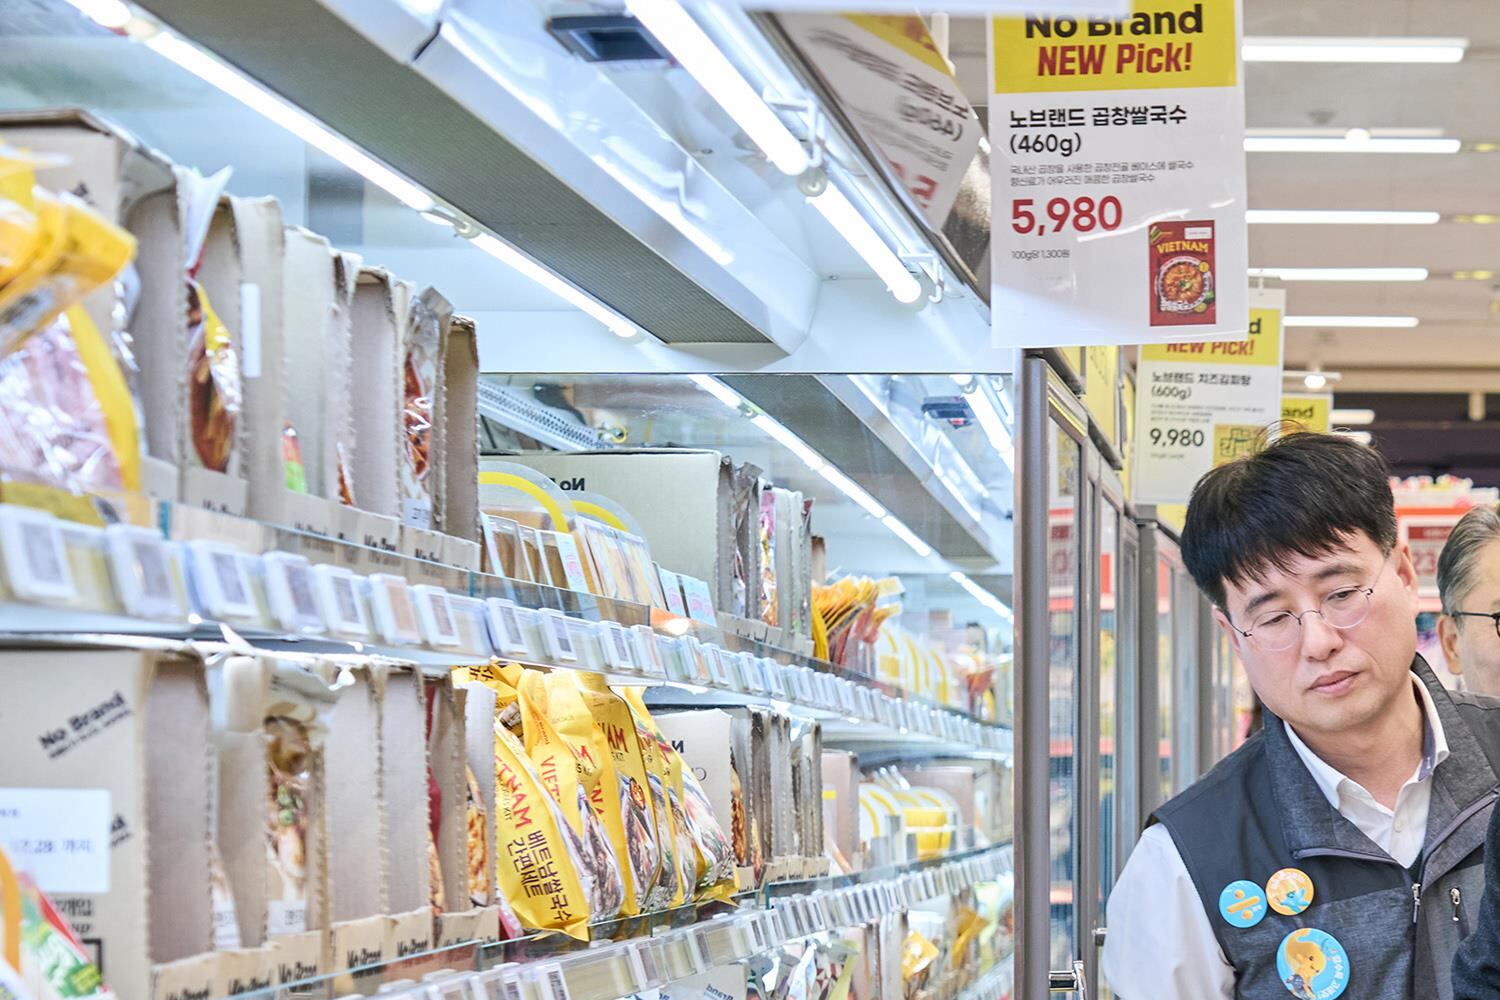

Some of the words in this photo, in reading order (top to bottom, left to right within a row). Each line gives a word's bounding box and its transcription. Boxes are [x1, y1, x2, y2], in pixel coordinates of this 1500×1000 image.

[1025, 14, 1078, 39] No
[1037, 44, 1107, 76] NEW
[1116, 42, 1193, 74] Pick!
[1010, 108, 1085, 128] 노브랜드
[1092, 105, 1187, 126] 곱창쌀국수
[1009, 132, 1082, 157] (460g)
[1011, 195, 1123, 236] 5,980
[1157, 241, 1209, 254] VIETNAM
[1151, 386, 1192, 400] (600g)
[1282, 406, 1315, 419] and
[1150, 428, 1205, 448] 9,980
[506, 836, 545, 899] 간편세트
[525, 829, 573, 923] 베트남쌀국수
